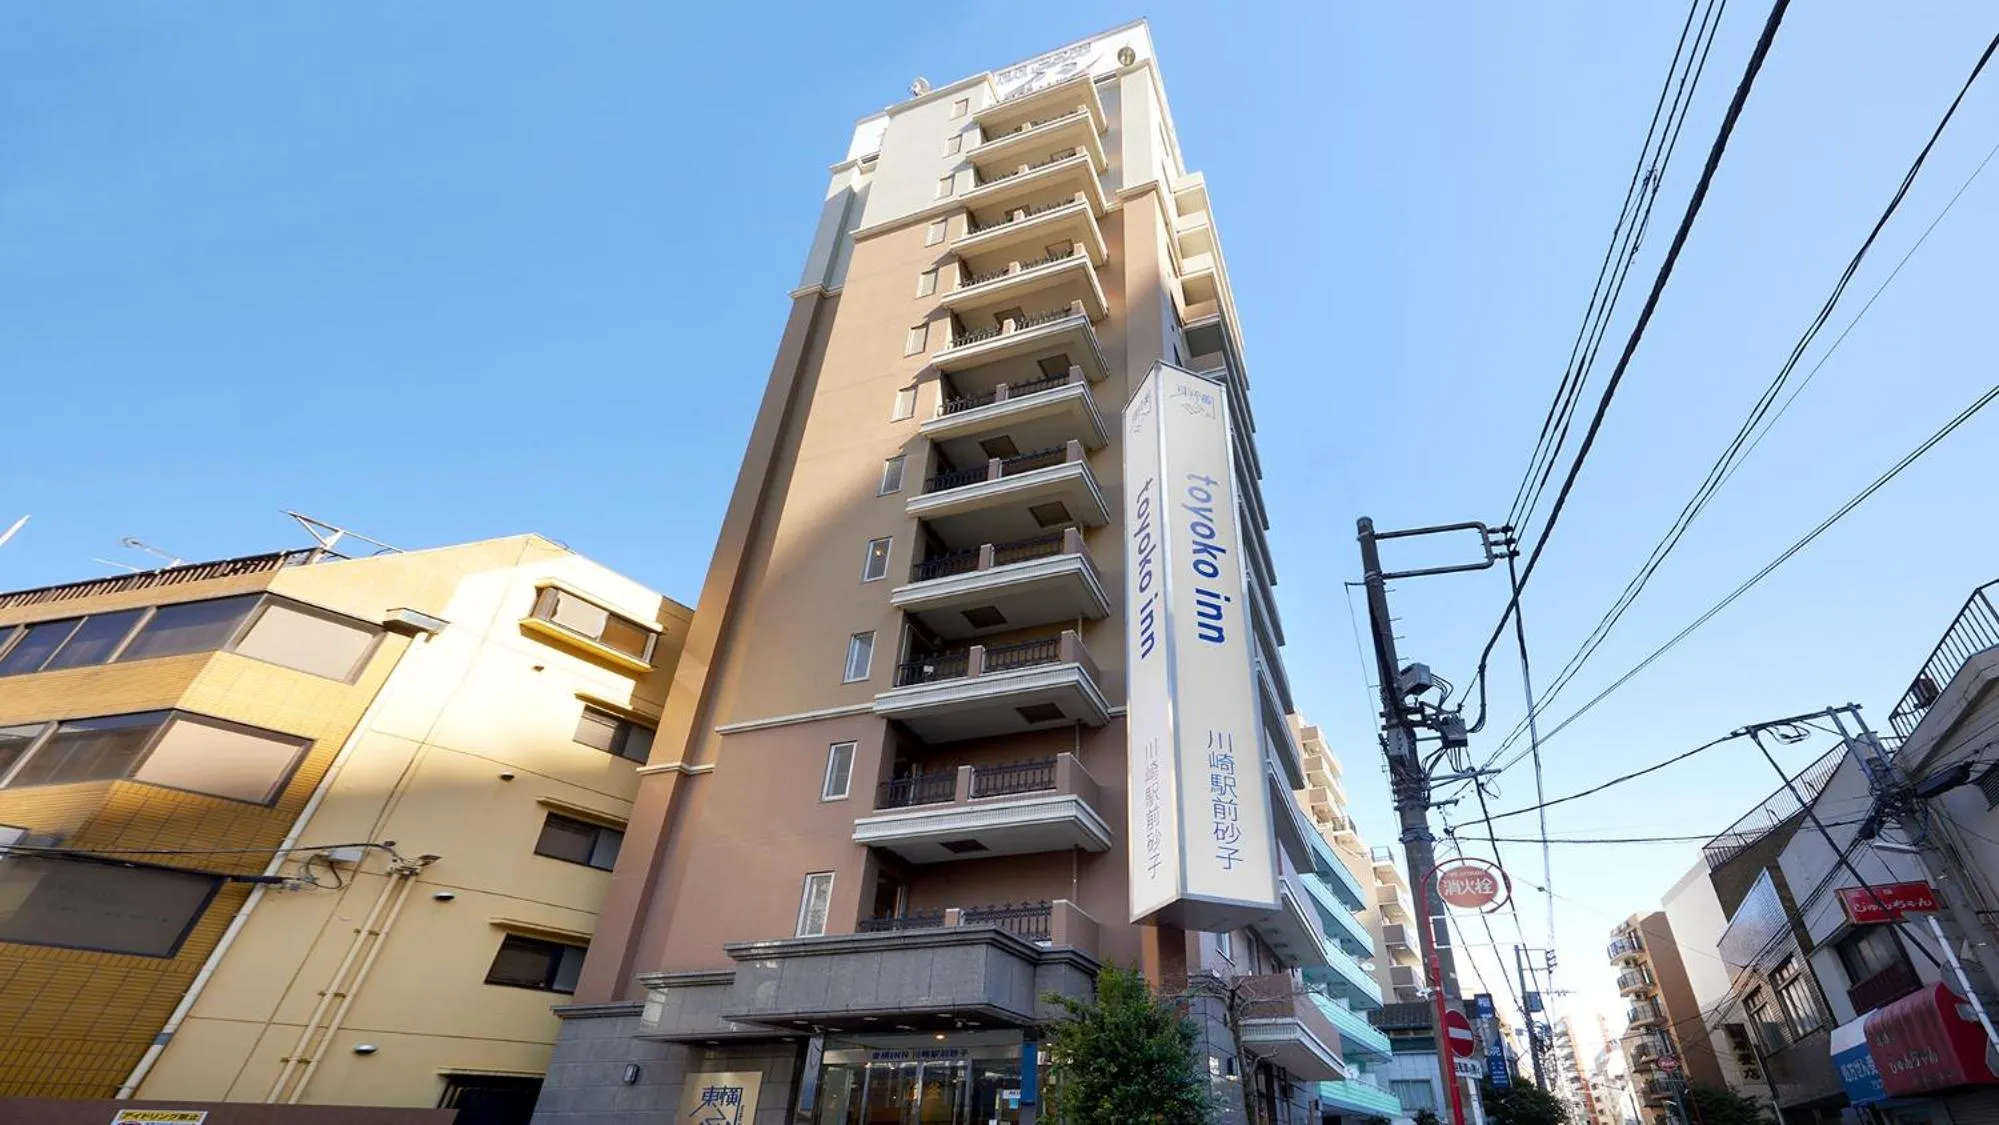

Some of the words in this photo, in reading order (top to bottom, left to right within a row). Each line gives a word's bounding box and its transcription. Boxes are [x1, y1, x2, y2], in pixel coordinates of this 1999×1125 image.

[1134, 477, 1157, 593] toyoko
[1181, 473, 1227, 579] toyoko
[1139, 591, 1159, 659] inn
[1195, 587, 1231, 644] inn
[1207, 730, 1244, 870] 川崎駅前砂子
[1443, 878, 1494, 896] 消火栓
